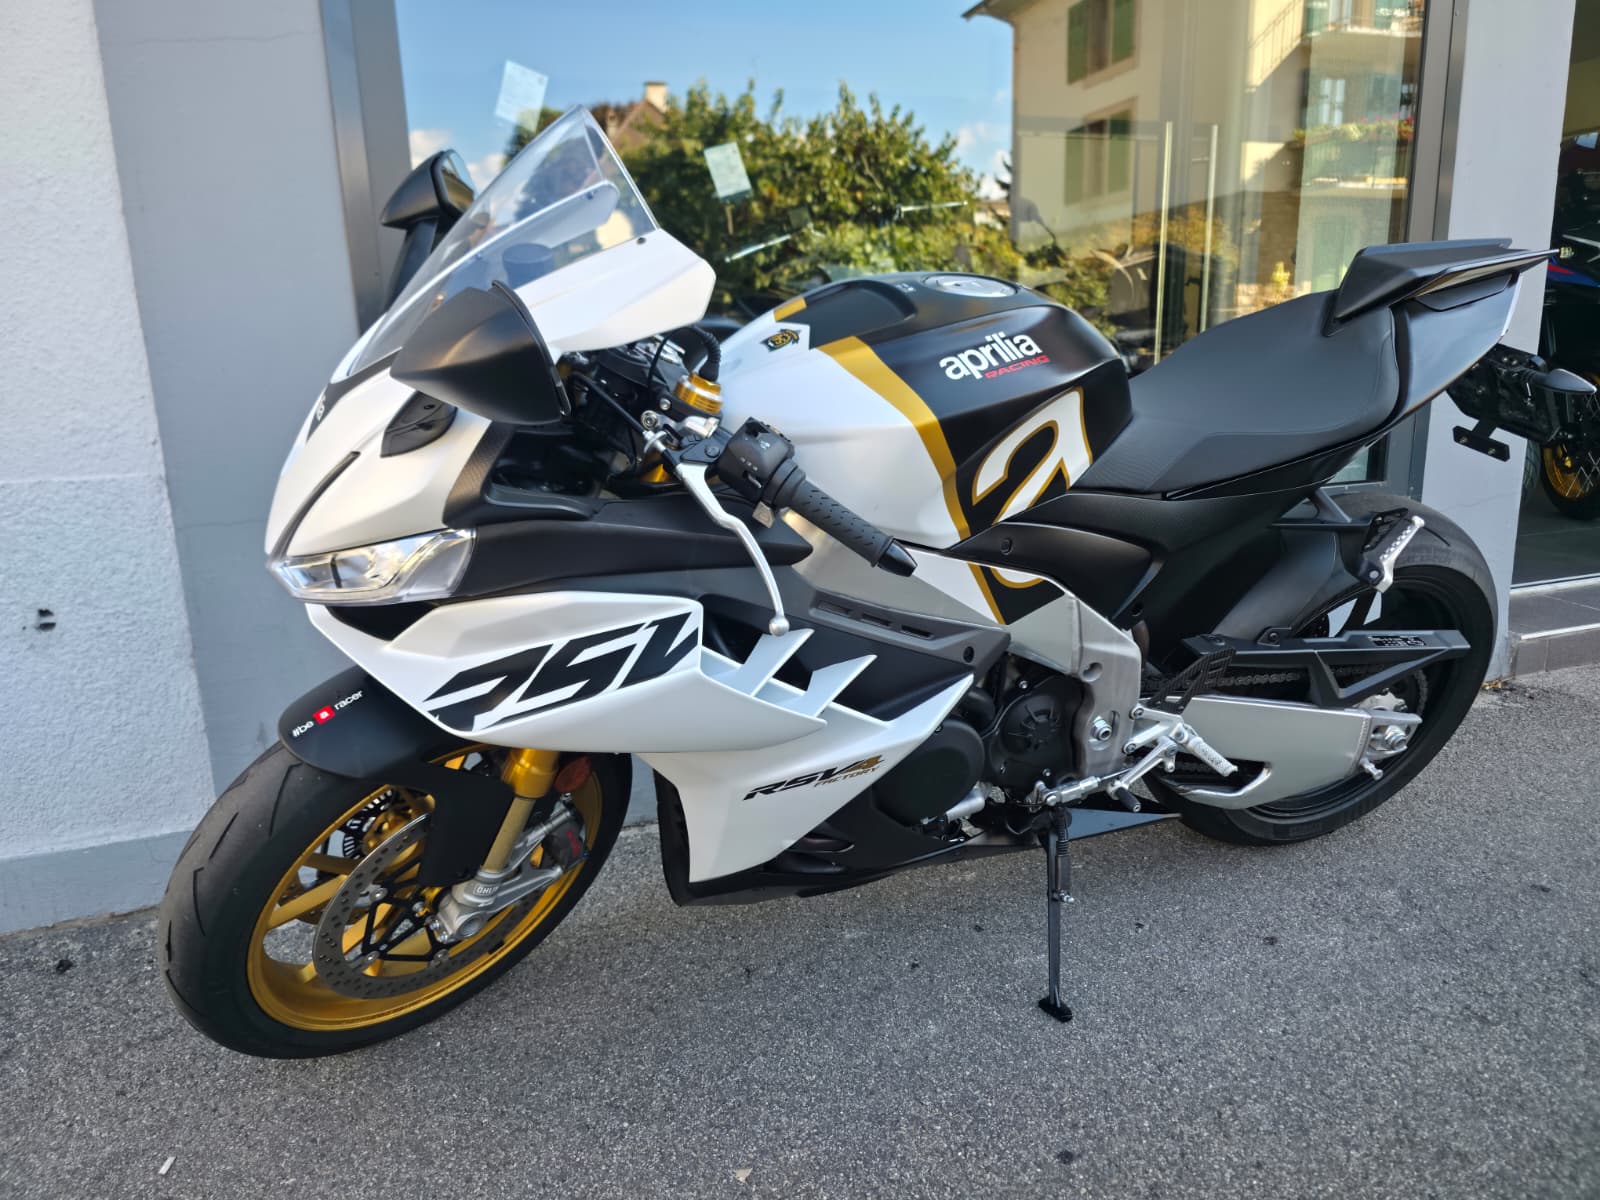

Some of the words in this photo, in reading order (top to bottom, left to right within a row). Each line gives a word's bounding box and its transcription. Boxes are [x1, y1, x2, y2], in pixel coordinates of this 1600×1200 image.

[939, 331, 1043, 380] aprilia
[984, 355, 1050, 378] RACING
[334, 691, 362, 710] racer
[814, 766, 880, 788] FACTORY
